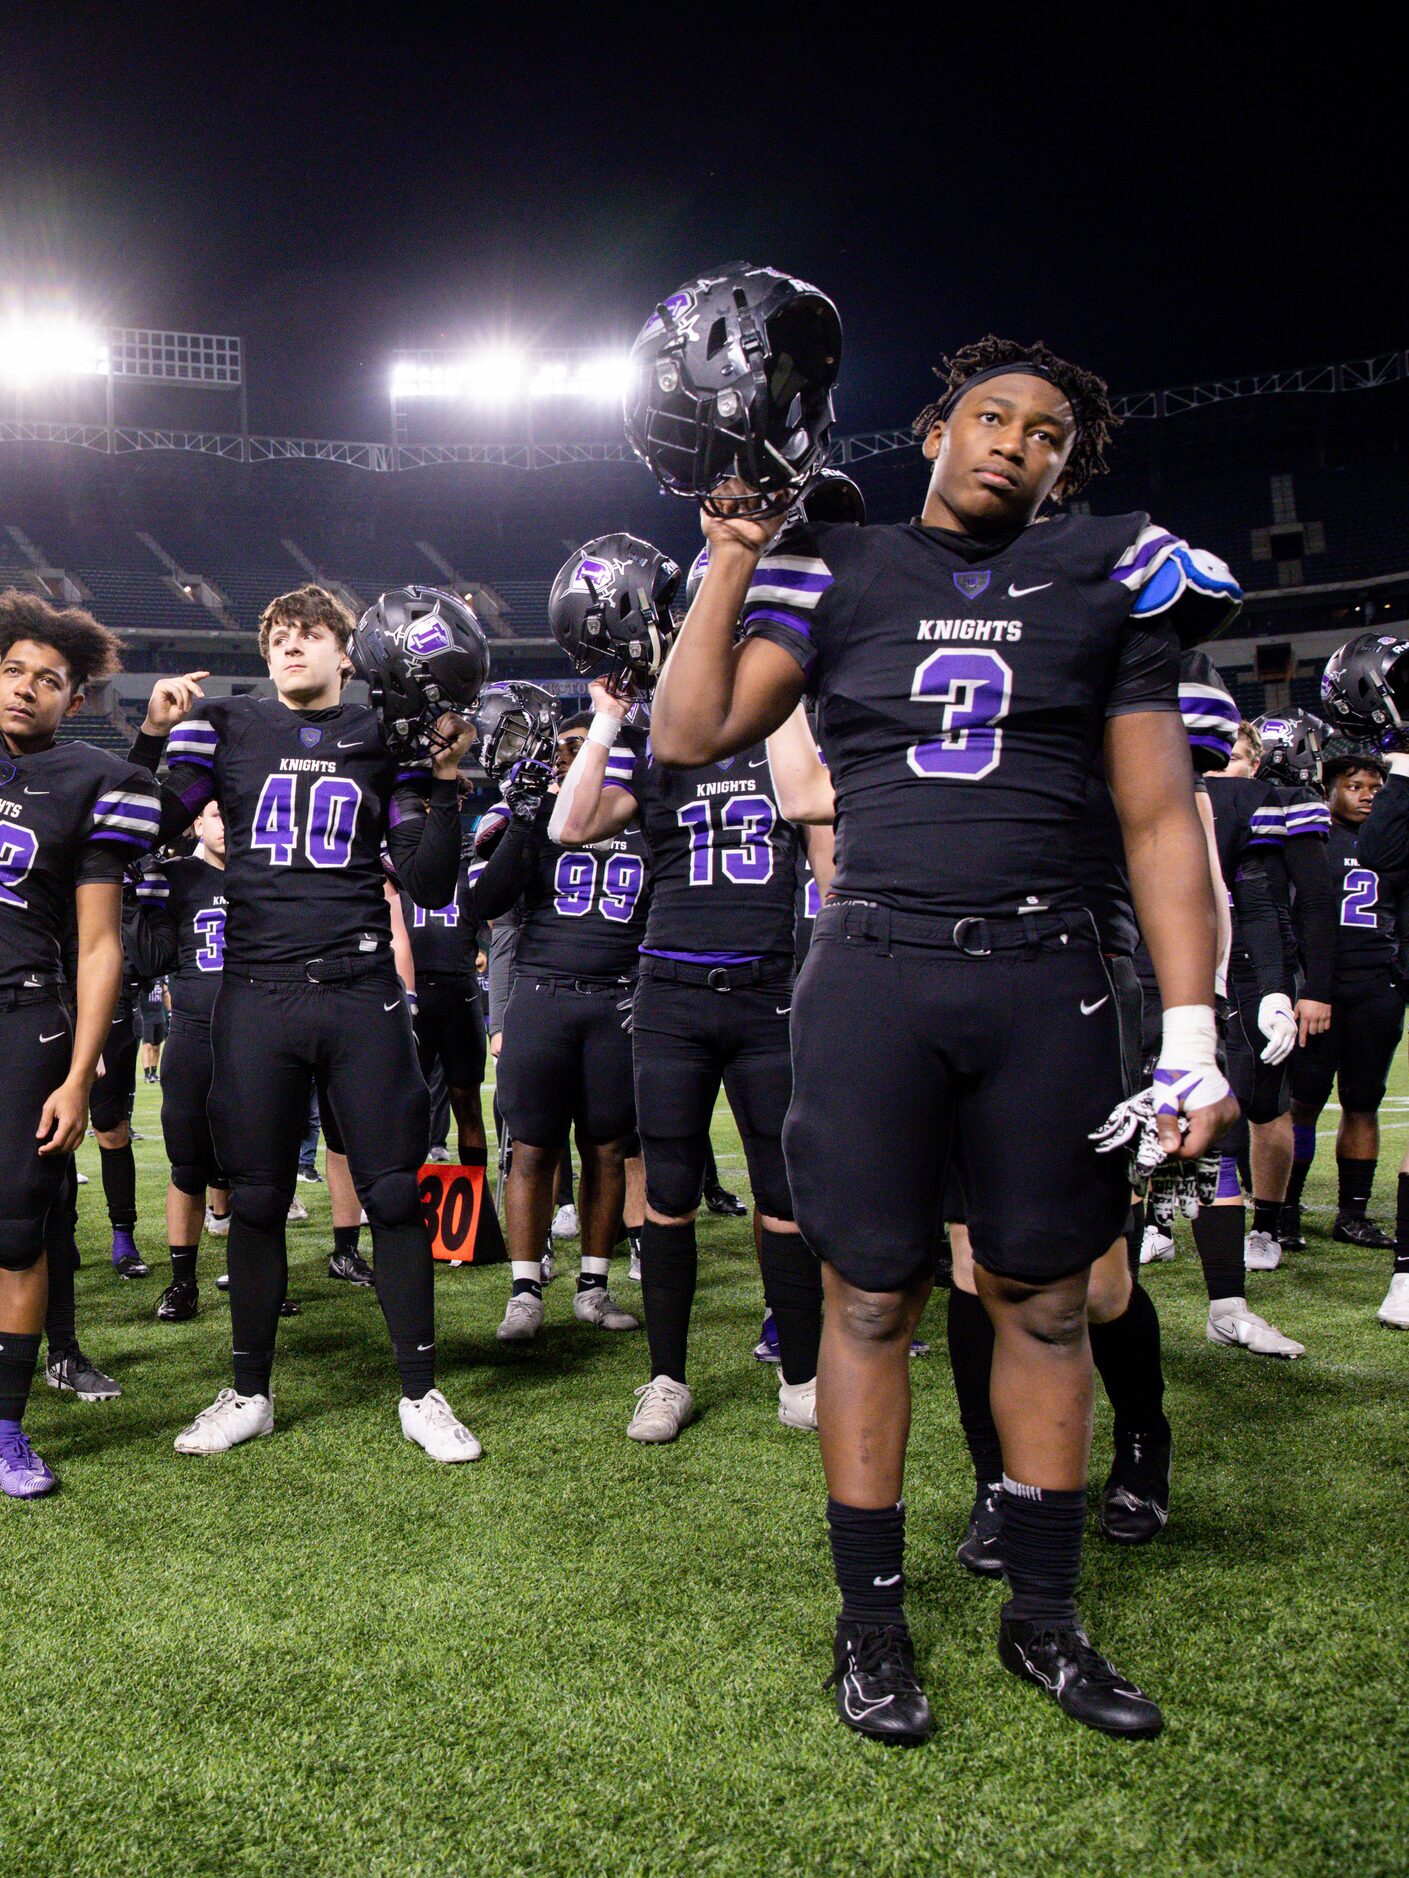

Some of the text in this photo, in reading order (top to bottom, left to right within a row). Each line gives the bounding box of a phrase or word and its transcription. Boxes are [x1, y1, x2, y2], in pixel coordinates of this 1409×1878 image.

[917, 619, 1023, 642] KNIGHTS
[907, 648, 1013, 781] 3
[280, 758, 337, 773] KNIGHTS
[696, 779, 756, 797] KNIGHTS
[250, 774, 363, 868] 40
[676, 794, 777, 886] 13
[553, 851, 644, 923] 99
[1340, 868, 1379, 928] 2
